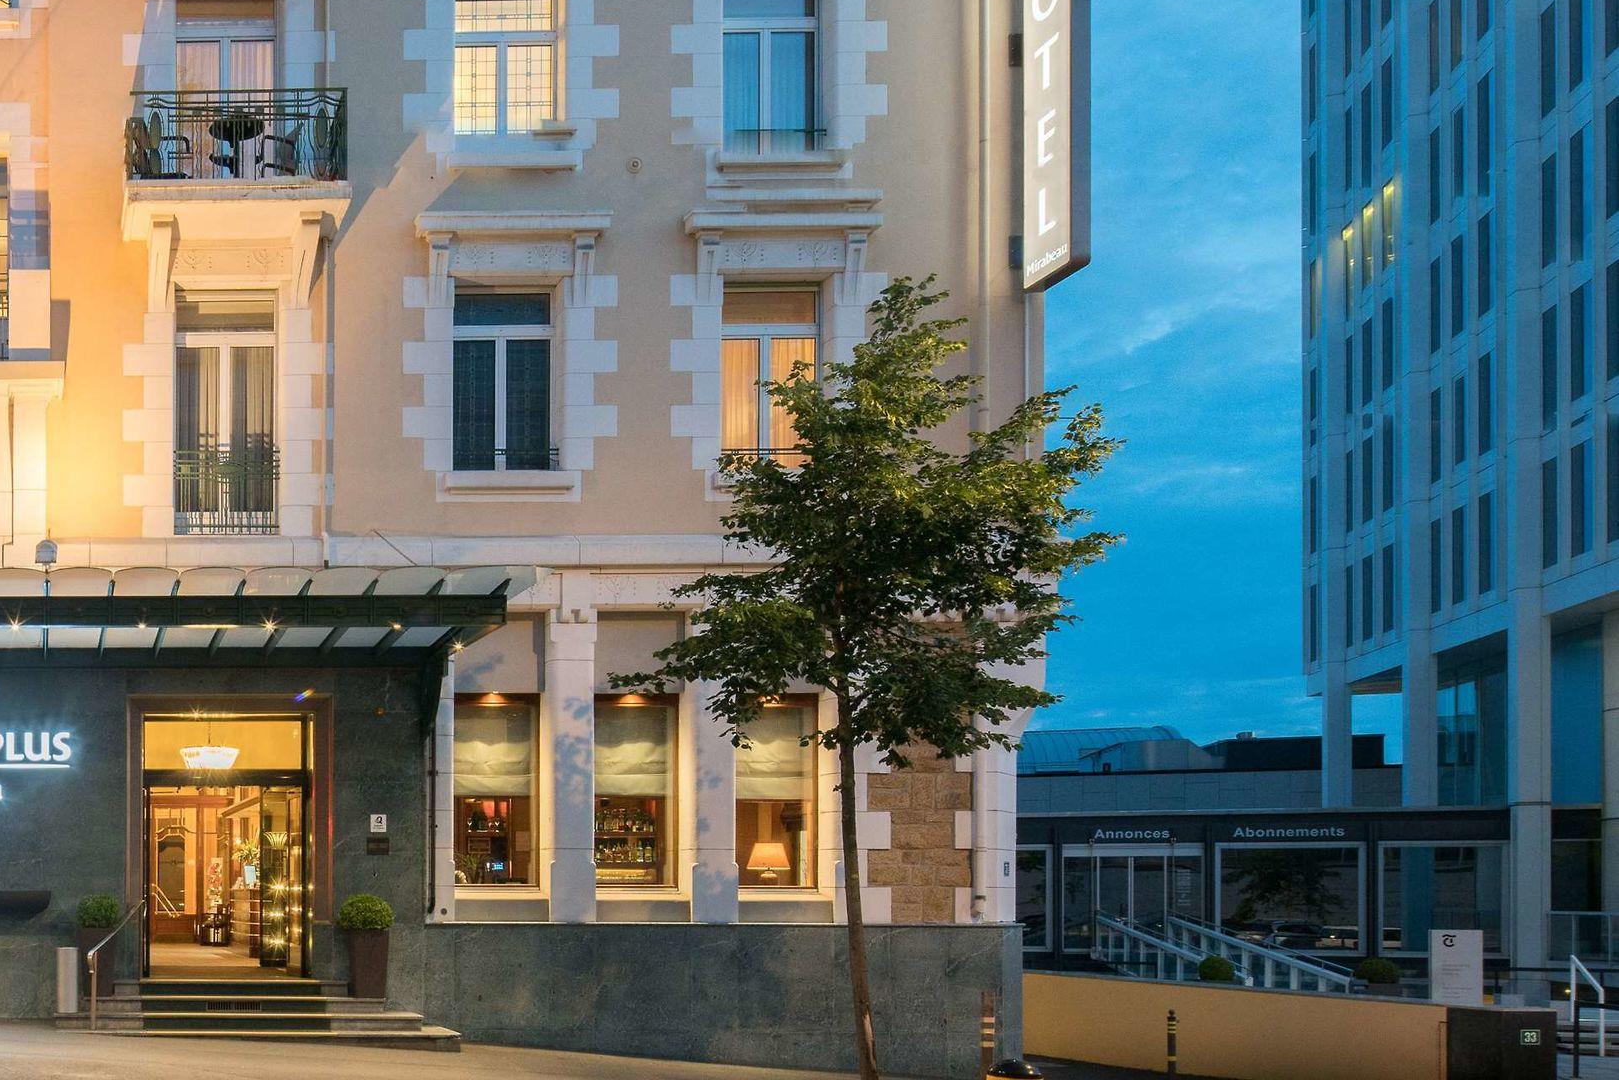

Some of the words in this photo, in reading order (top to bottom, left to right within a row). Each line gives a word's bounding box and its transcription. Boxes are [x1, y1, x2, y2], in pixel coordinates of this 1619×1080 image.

[1026, 243, 1068, 277] Mirabeau
[1094, 828, 1171, 840] Annonces
[1233, 826, 1346, 839] Abonnements
[1524, 1032, 1537, 1042] 33
